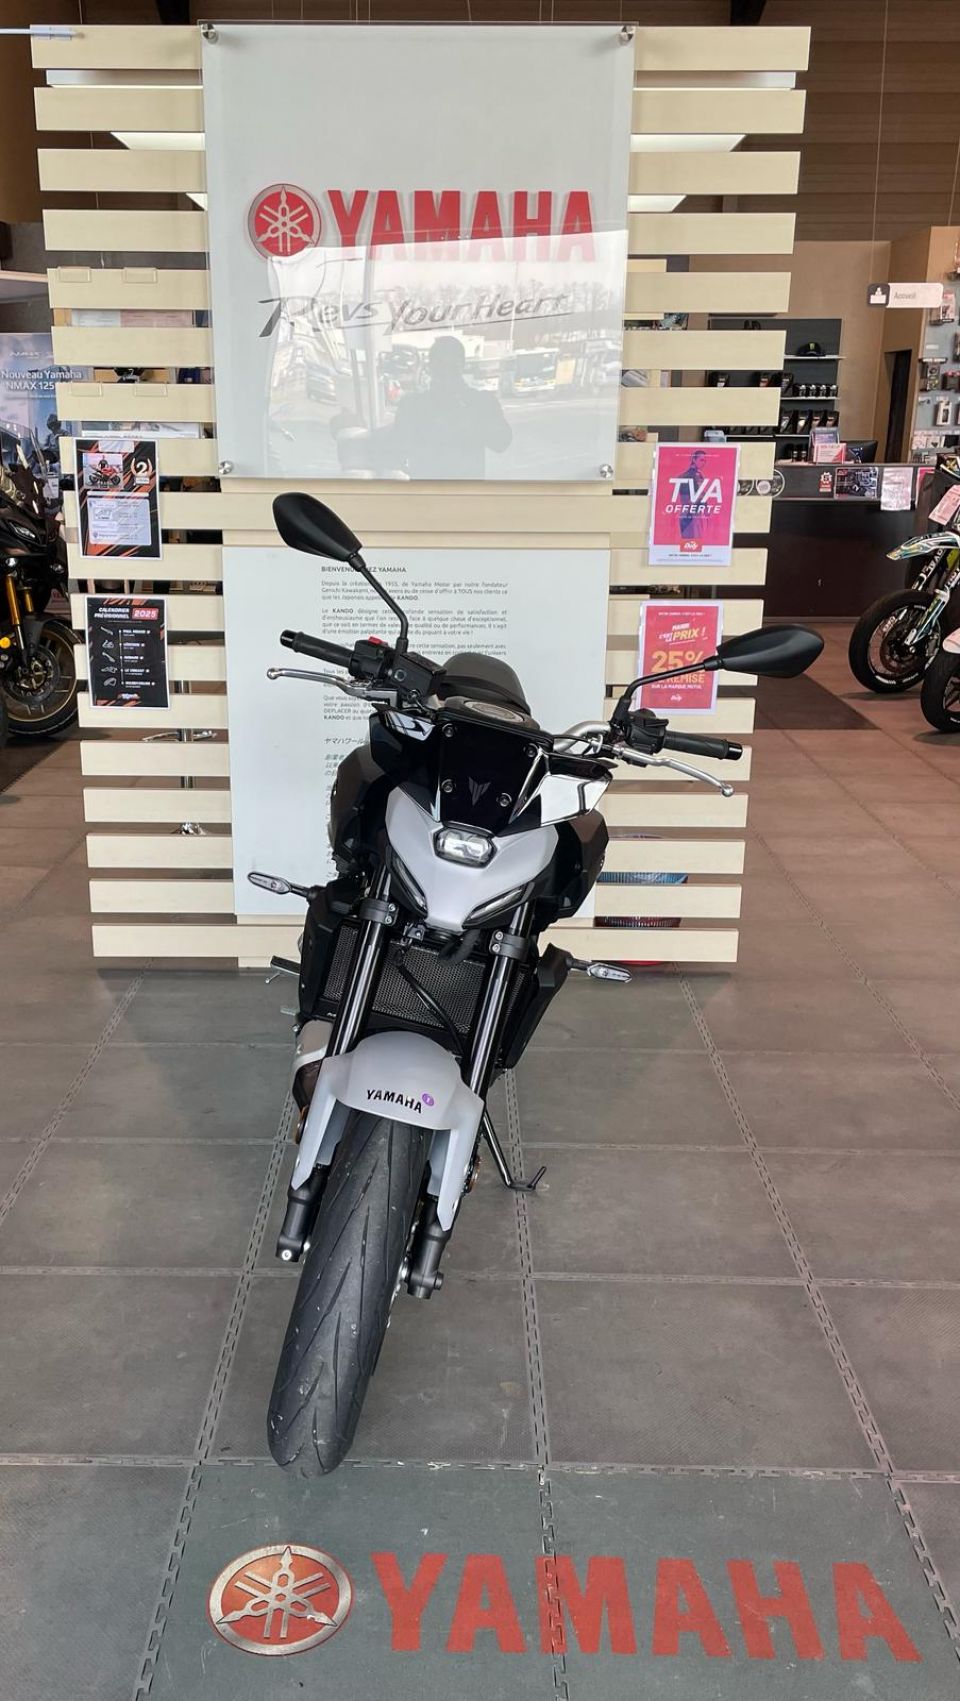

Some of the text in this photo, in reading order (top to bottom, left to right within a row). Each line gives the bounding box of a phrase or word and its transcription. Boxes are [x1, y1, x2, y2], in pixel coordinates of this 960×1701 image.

[326, 189, 595, 263] YAMAHA
[1, 370, 82, 379] Nouveau Yamaha
[7, 381, 55, 390] NMAX 125
[669, 477, 722, 503] TVA
[665, 504, 721, 514] OFFERTE
[134, 609, 156, 618] 2025
[673, 628, 699, 641] PRIX
[366, 1089, 422, 1113] YAMAHA
[370, 1552, 924, 1662] YAMAHA
